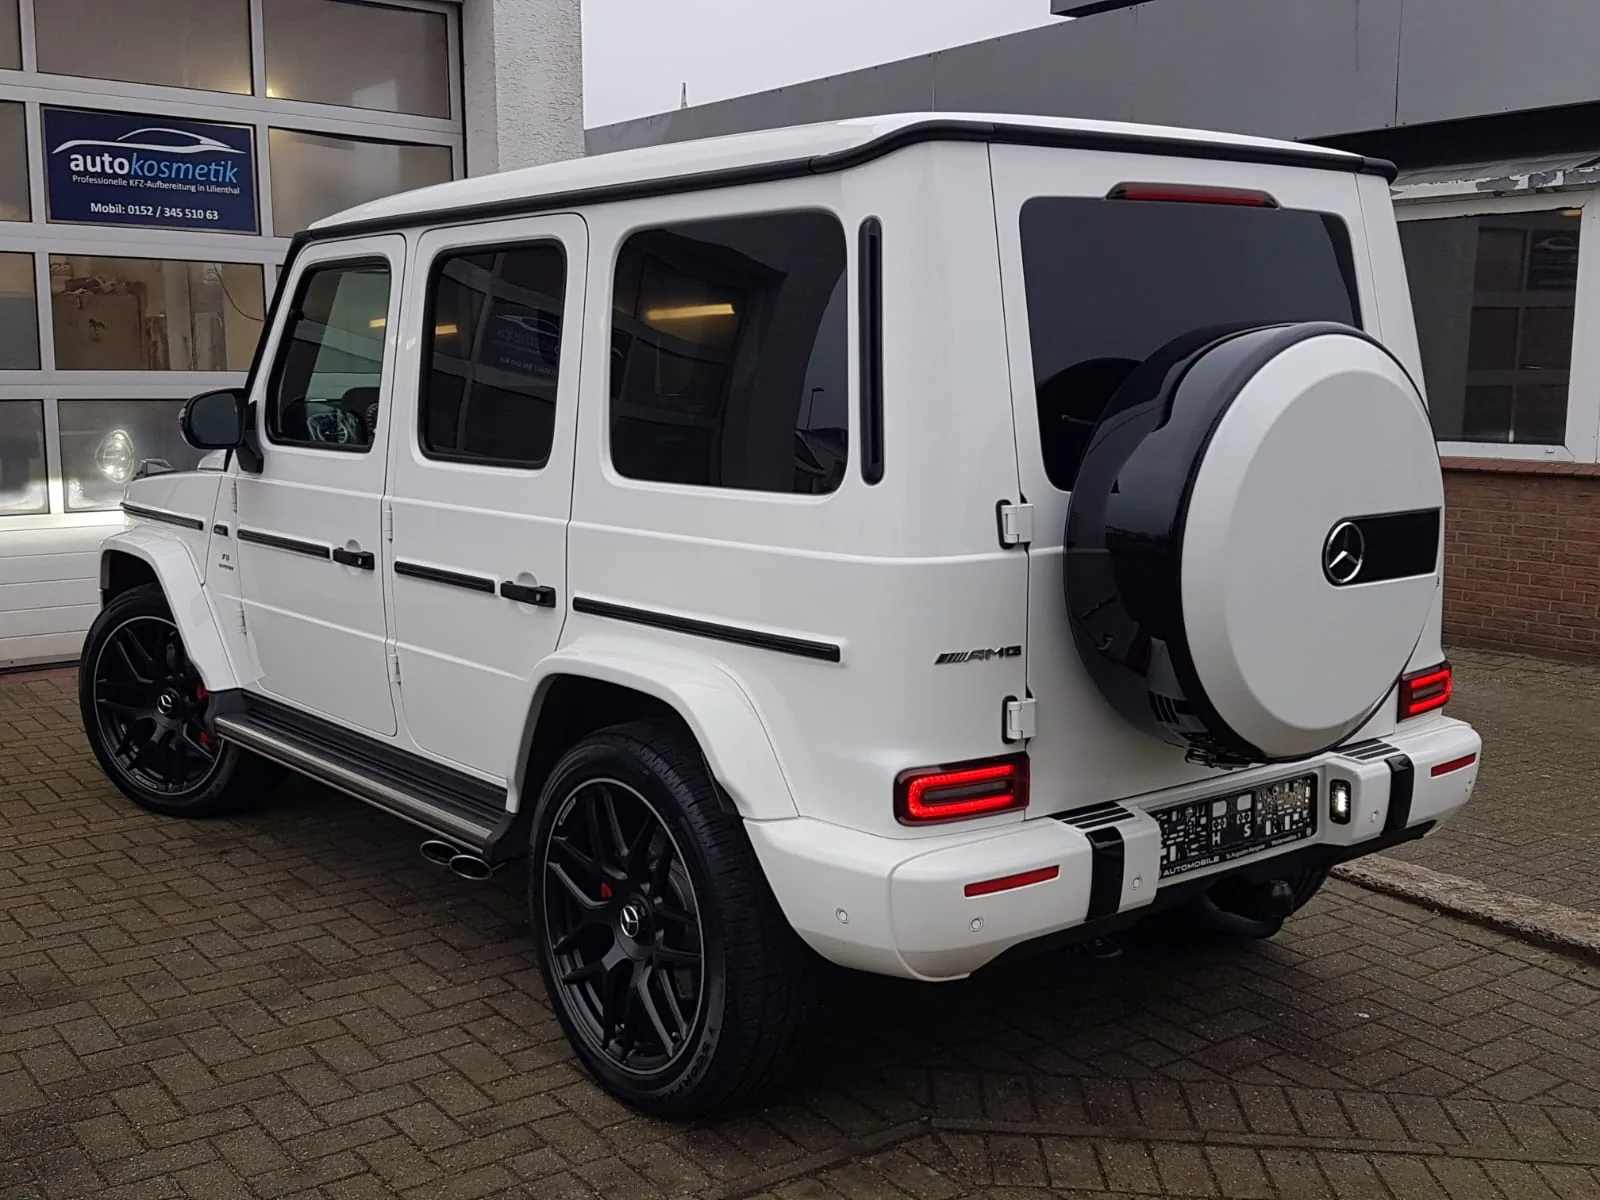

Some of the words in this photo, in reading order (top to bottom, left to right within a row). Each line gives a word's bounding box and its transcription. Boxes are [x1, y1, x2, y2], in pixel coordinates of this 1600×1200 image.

[69, 152, 239, 183] autokosmetik
[72, 174, 128, 187] Professionelle
[129, 179, 197, 193] KFZ-Aufbereitung
[197, 184, 206, 192] in
[206, 185, 241, 195] Lilienthal
[90, 202, 126, 214] Mobil:
[127, 204, 154, 216] 0152
[155, 206, 162, 218] /
[163, 207, 183, 218] 345
[184, 209, 204, 219] 510
[206, 210, 219, 220] 63
[965, 645, 1022, 663] AMG
[1162, 855, 1220, 877] AUTOMOBILE
